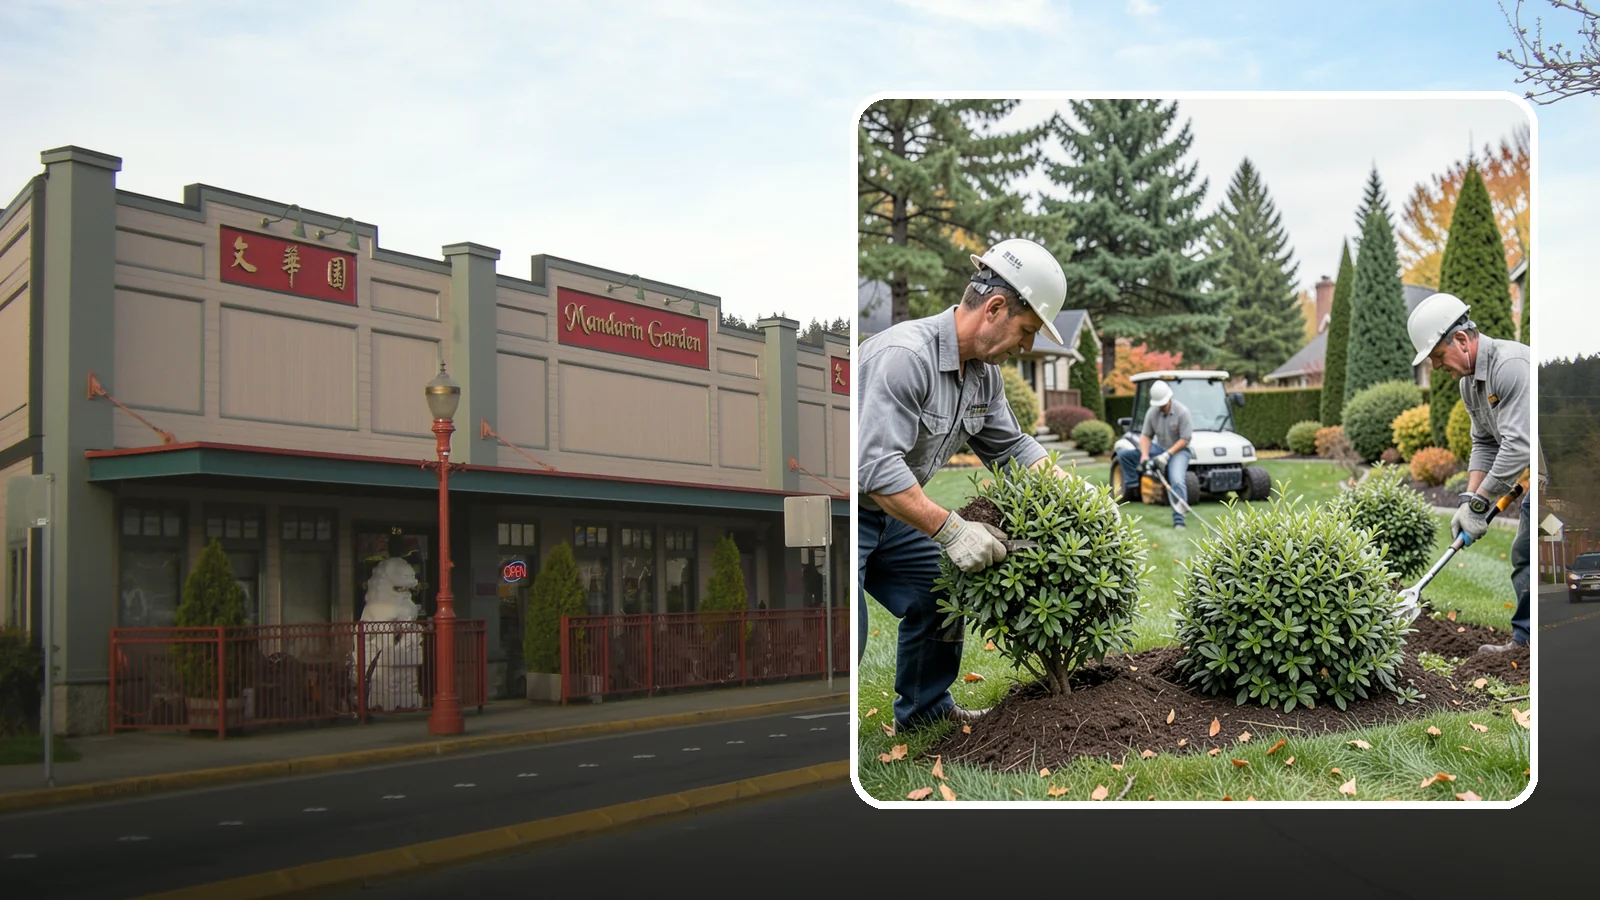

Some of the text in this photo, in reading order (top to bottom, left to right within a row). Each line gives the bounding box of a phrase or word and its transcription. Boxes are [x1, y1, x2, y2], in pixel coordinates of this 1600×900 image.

[231, 235, 346, 291] 文華園
[564, 302, 702, 352] Mandarin Garden
[835, 363, 846, 386] 文
[503, 565, 527, 578] OPEN
